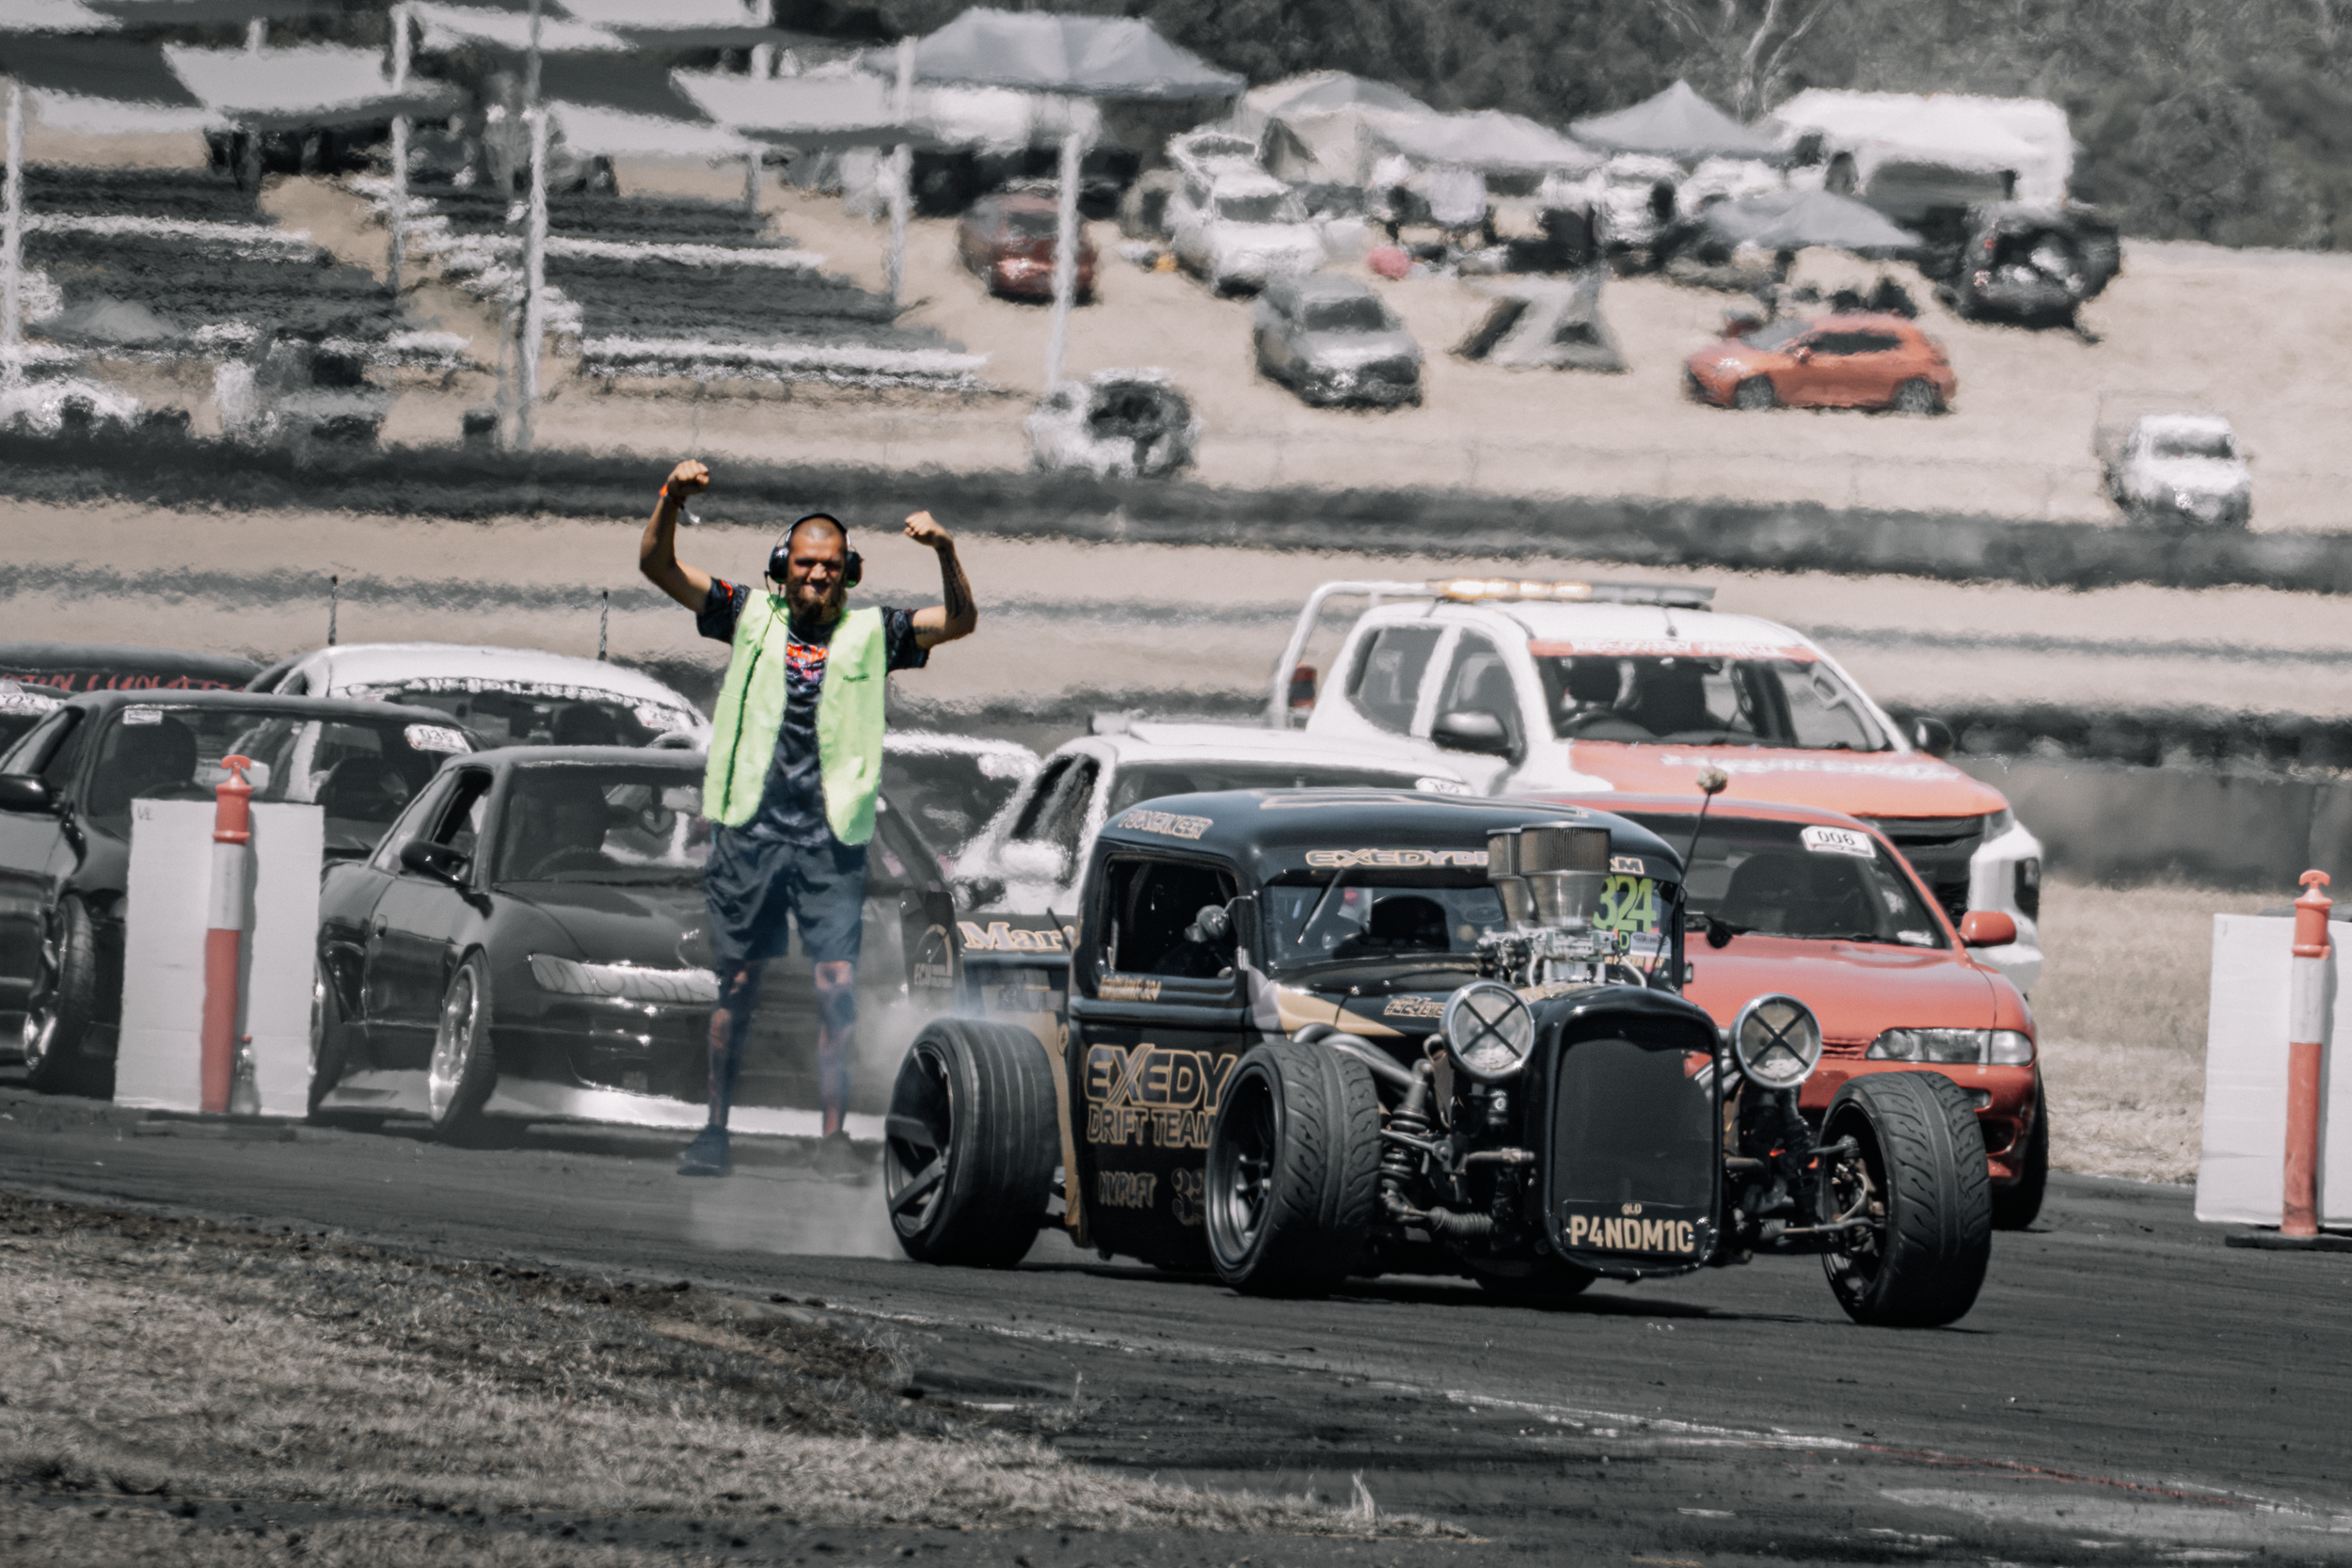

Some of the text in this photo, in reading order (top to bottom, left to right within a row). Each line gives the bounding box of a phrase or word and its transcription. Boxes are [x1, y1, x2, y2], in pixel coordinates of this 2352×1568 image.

[1593, 875, 1657, 933] 324
[1085, 1043, 1238, 1112] EXEDY
[1087, 1103, 1217, 1149] DRIFT TEAM
[1570, 1214, 1694, 1253] P4NDM1C
